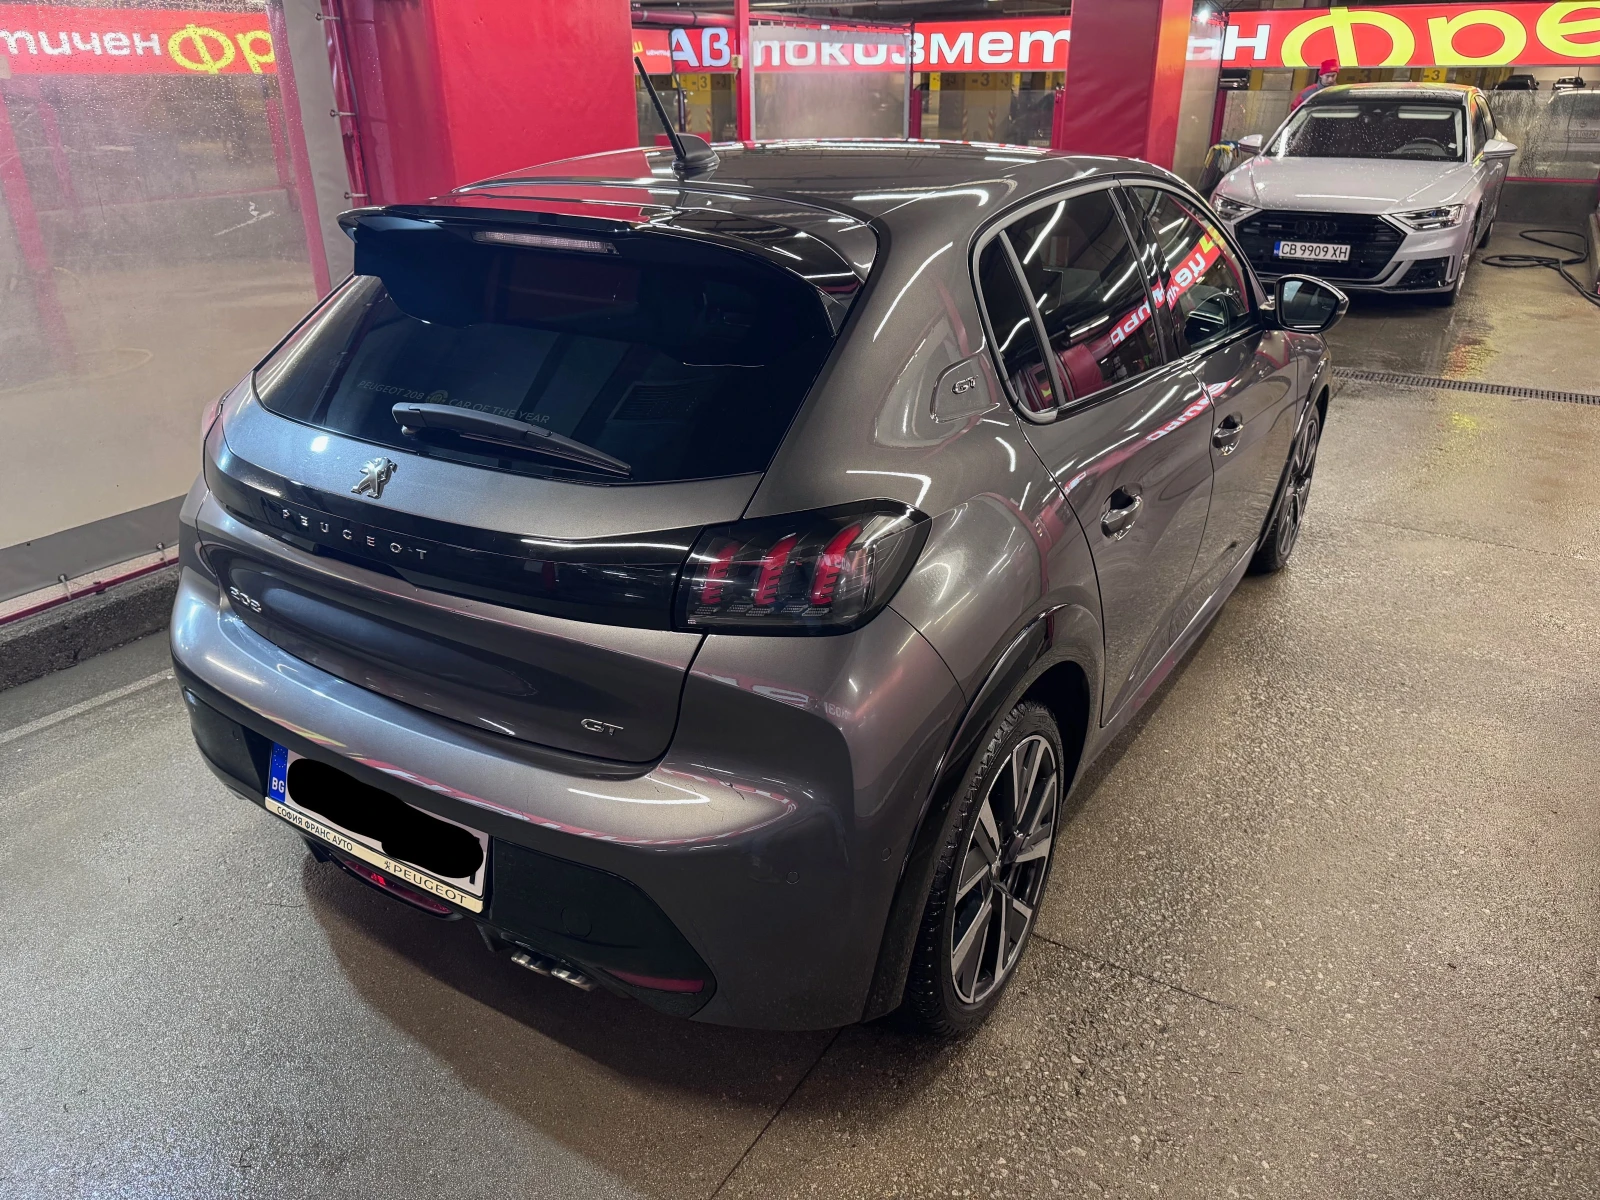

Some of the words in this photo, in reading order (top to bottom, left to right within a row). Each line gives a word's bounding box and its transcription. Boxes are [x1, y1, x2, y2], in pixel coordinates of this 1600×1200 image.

[971, 72, 990, 87] -3
[1422, 69, 1442, 82] -3
[1299, 244, 1330, 258] 9909
[951, 374, 979, 395] GT
[357, 380, 403, 396] PEUGEOT
[403, 389, 425, 401] 208
[449, 398, 471, 410] CAR
[470, 404, 490, 414] OF
[492, 406, 516, 419] THE
[518, 410, 550, 425] YEAR
[282, 508, 428, 561] PEUGEOT
[230, 586, 262, 614] 208
[580, 718, 624, 736] GT
[271, 776, 286, 794] BG
[276, 806, 303, 827] СОФИЯ
[304, 820, 331, 842] ФРАНС
[332, 835, 353, 852] АУТО
[393, 864, 467, 904] PEUGEOT
